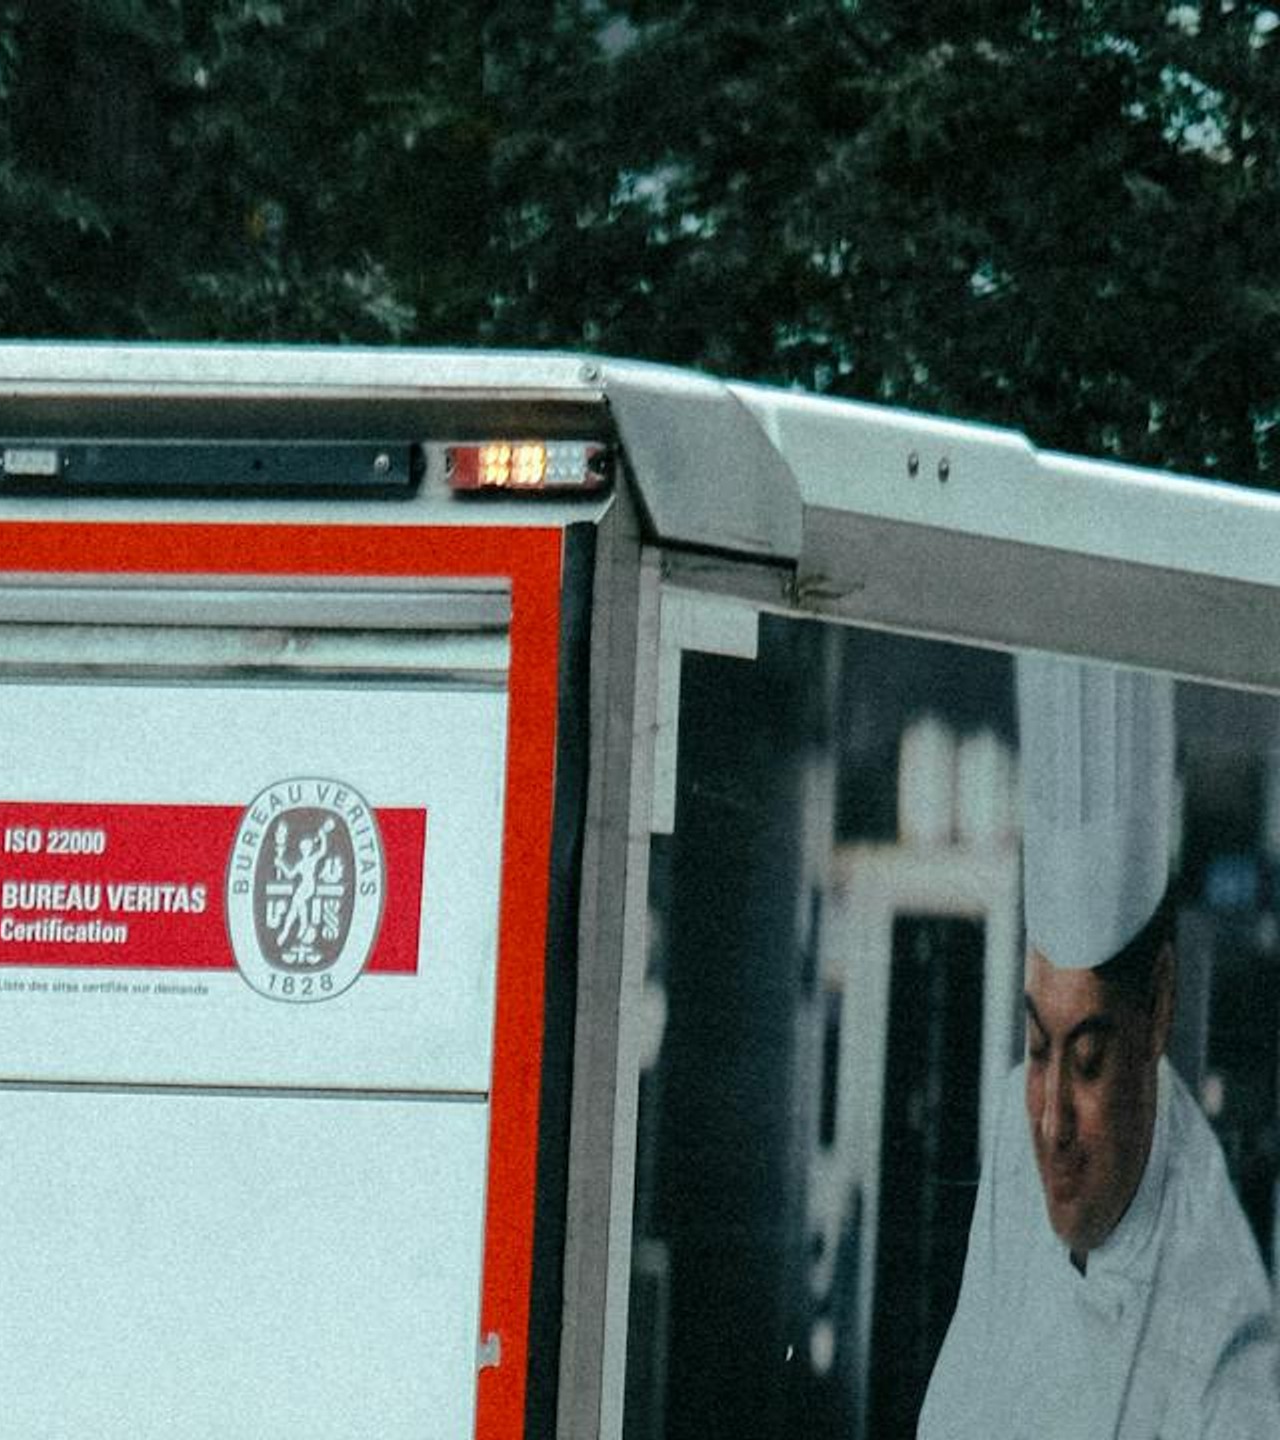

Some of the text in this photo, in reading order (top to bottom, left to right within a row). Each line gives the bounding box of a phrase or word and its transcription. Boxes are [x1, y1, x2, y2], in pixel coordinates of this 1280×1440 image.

[4, 828, 106, 856] ISO 22000
[232, 784, 378, 897] BUREAU VERITAS
[1, 882, 207, 914] BUREAU VERITAS
[0, 916, 129, 944] Certification
[268, 973, 335, 996] 1828
